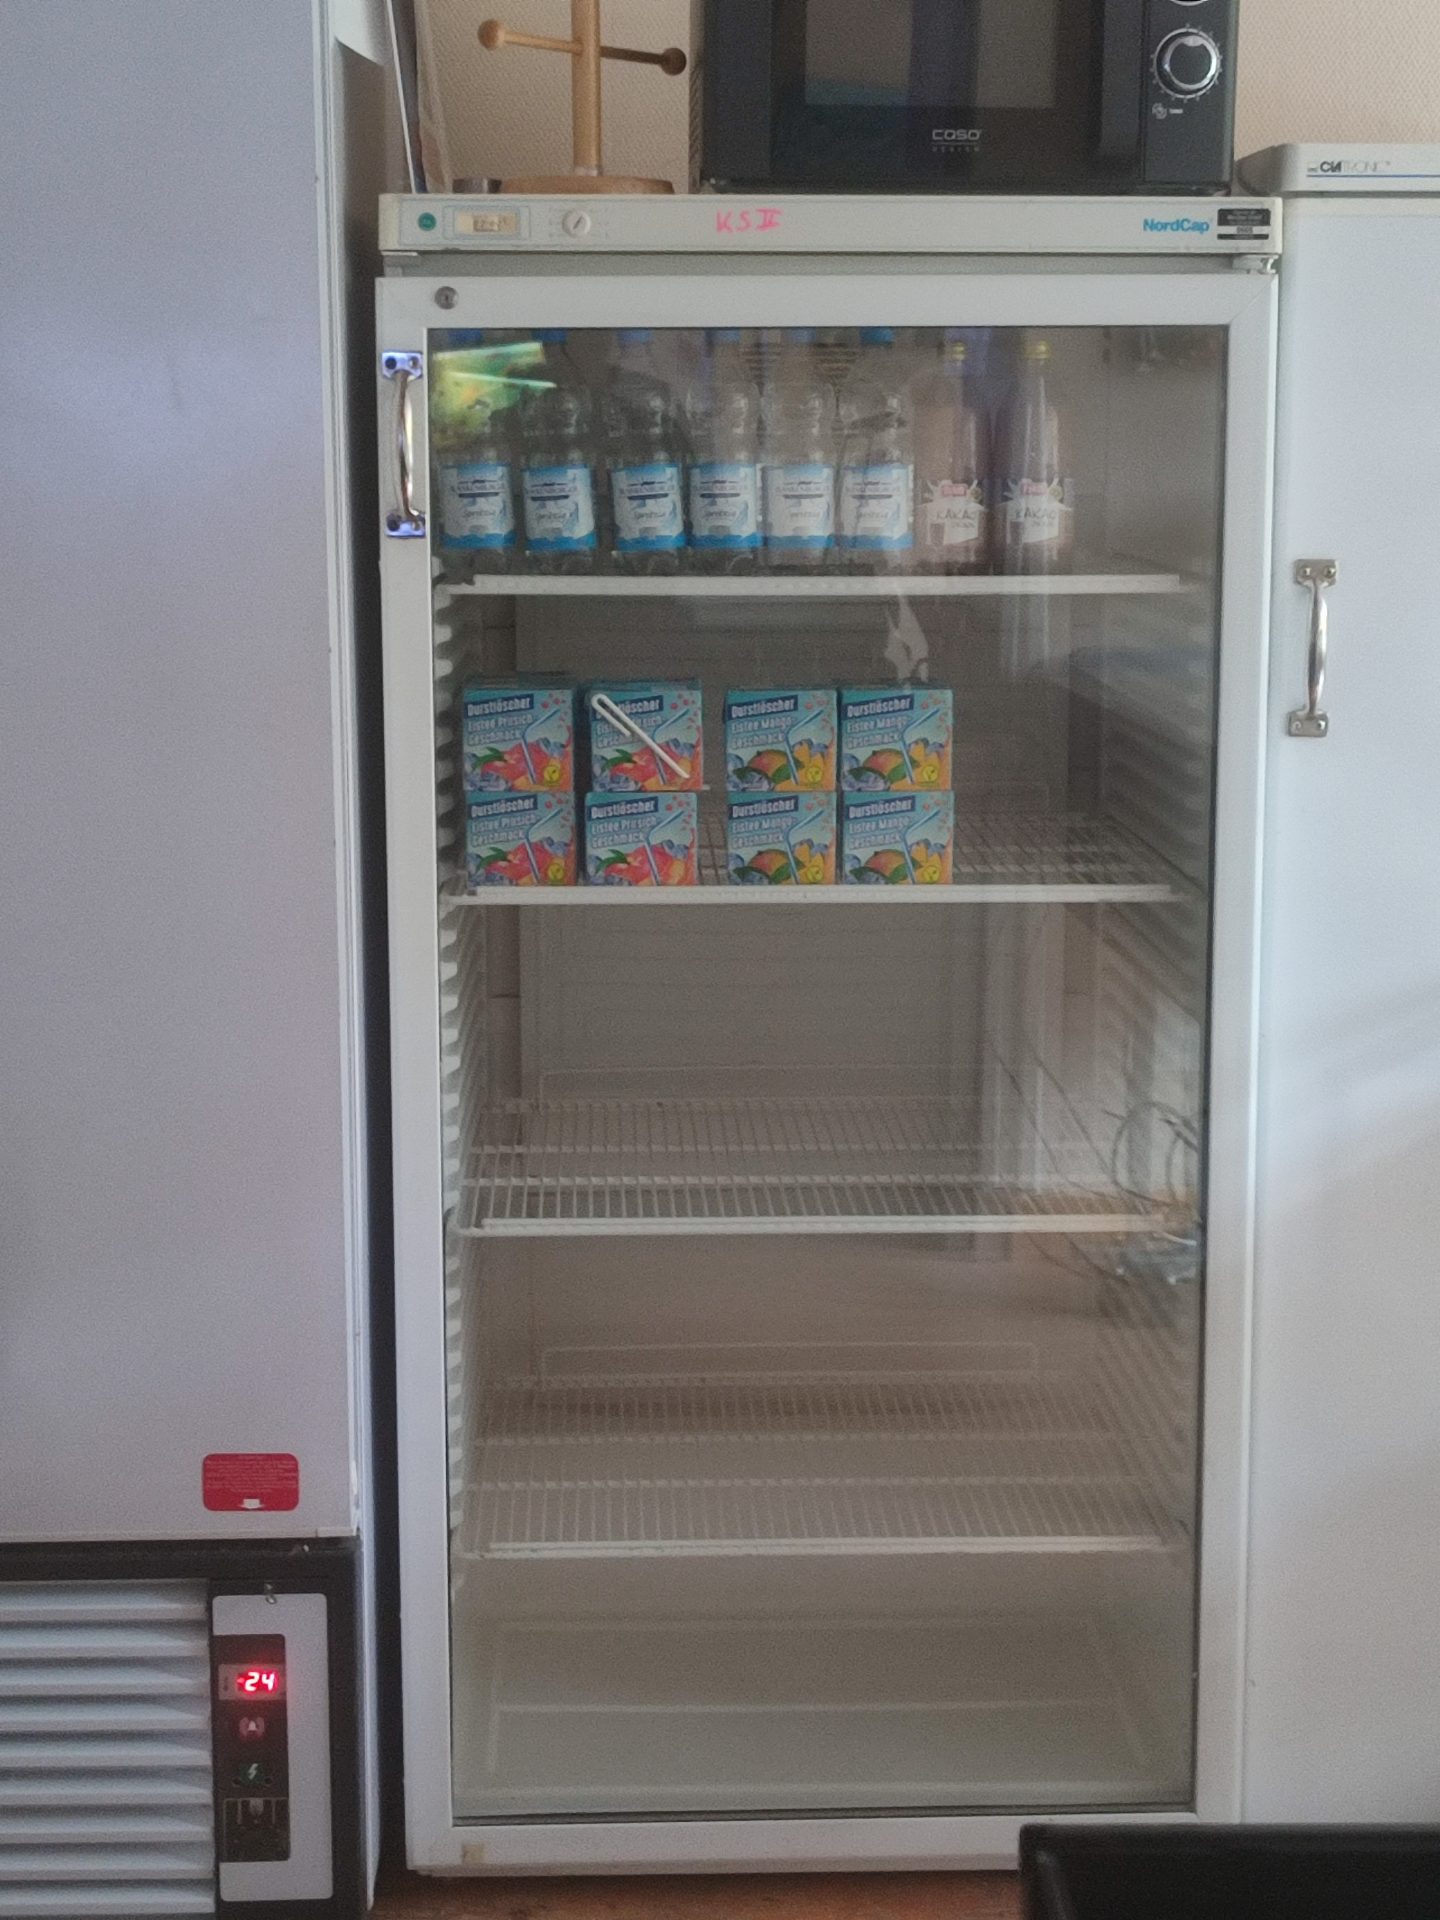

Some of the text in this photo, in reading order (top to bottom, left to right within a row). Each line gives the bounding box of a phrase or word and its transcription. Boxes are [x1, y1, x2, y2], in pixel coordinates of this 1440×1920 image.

[1143, 218, 1210, 234] NordCap
[467, 697, 530, 716] Durstlöscher
[731, 699, 795, 718] Durstlöscher
[847, 697, 911, 718] Durstlöscher
[471, 797, 535, 818] Durstlöscher
[591, 800, 655, 819] Durstlöscher
[732, 799, 795, 818] Durstlöscher
[848, 799, 912, 819] Durstlöscher
[237, 1671, 275, 1692] -24
